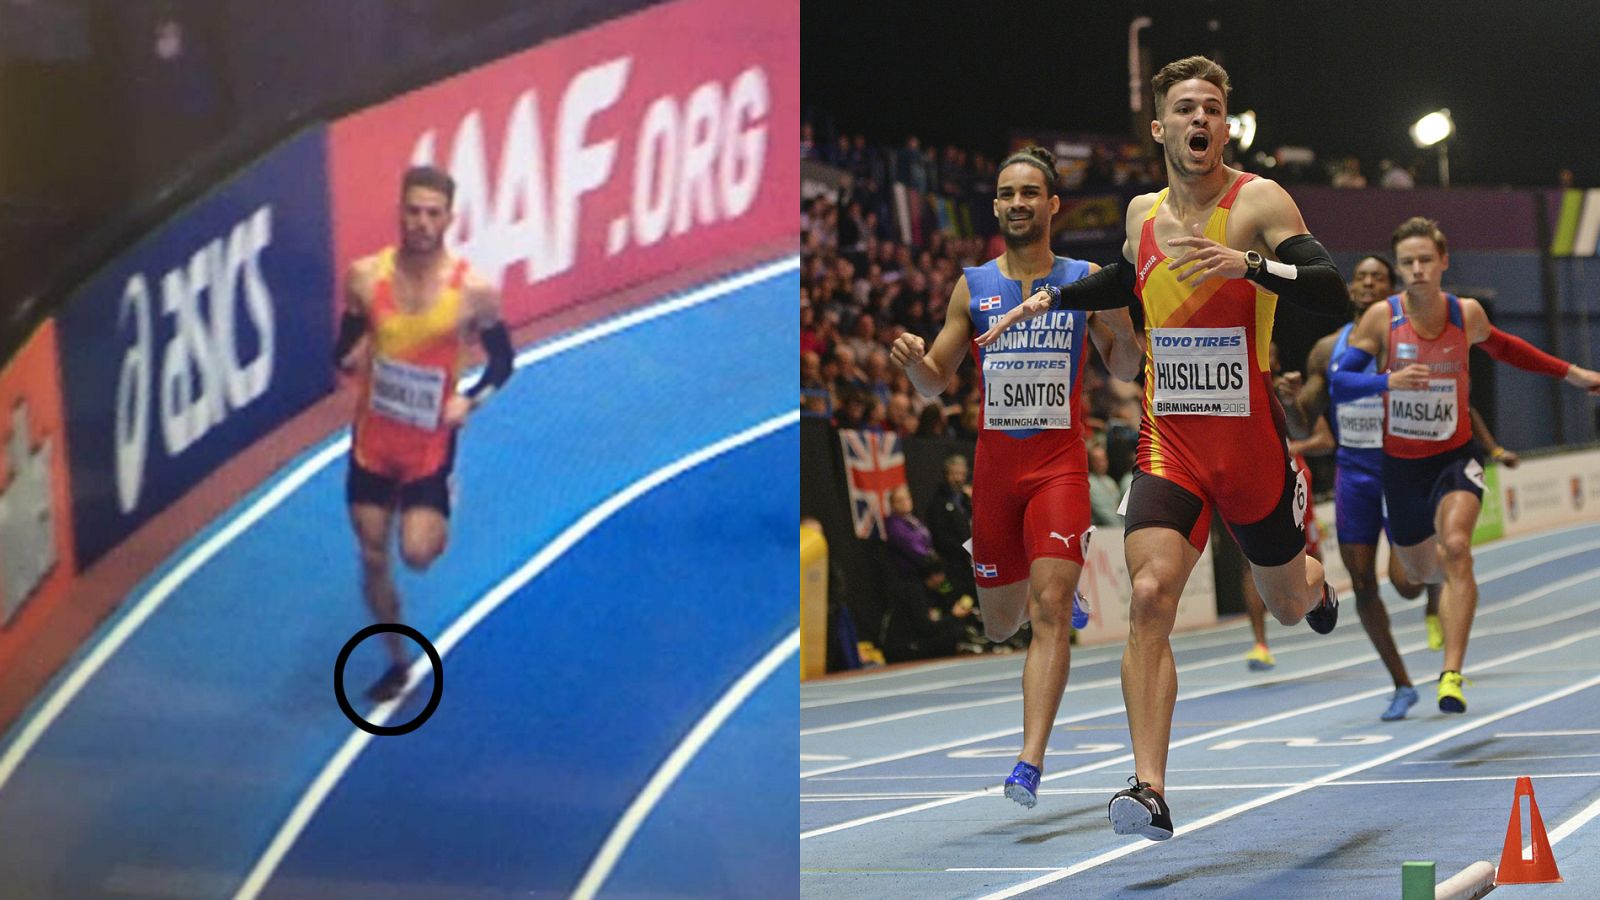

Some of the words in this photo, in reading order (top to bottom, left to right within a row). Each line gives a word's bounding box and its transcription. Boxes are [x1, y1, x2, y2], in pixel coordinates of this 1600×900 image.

[409, 54, 771, 288] AAF.ORG
[988, 312, 1074, 331] RBLICA
[1155, 337, 1191, 347] TOYO
[1194, 335, 1241, 347] TIRES
[989, 361, 1024, 369] TOYO
[1026, 360, 1066, 369] TIRES
[1157, 362, 1244, 391] HUSILLOS
[988, 383, 999, 406] L.
[1003, 383, 1066, 407] SANTOS
[1157, 402, 1222, 413] BIRMINGHAM
[1223, 403, 1246, 413] 2018
[1392, 398, 1454, 422] MASLÁK
[989, 418, 1048, 427] BIRMINGHAM
